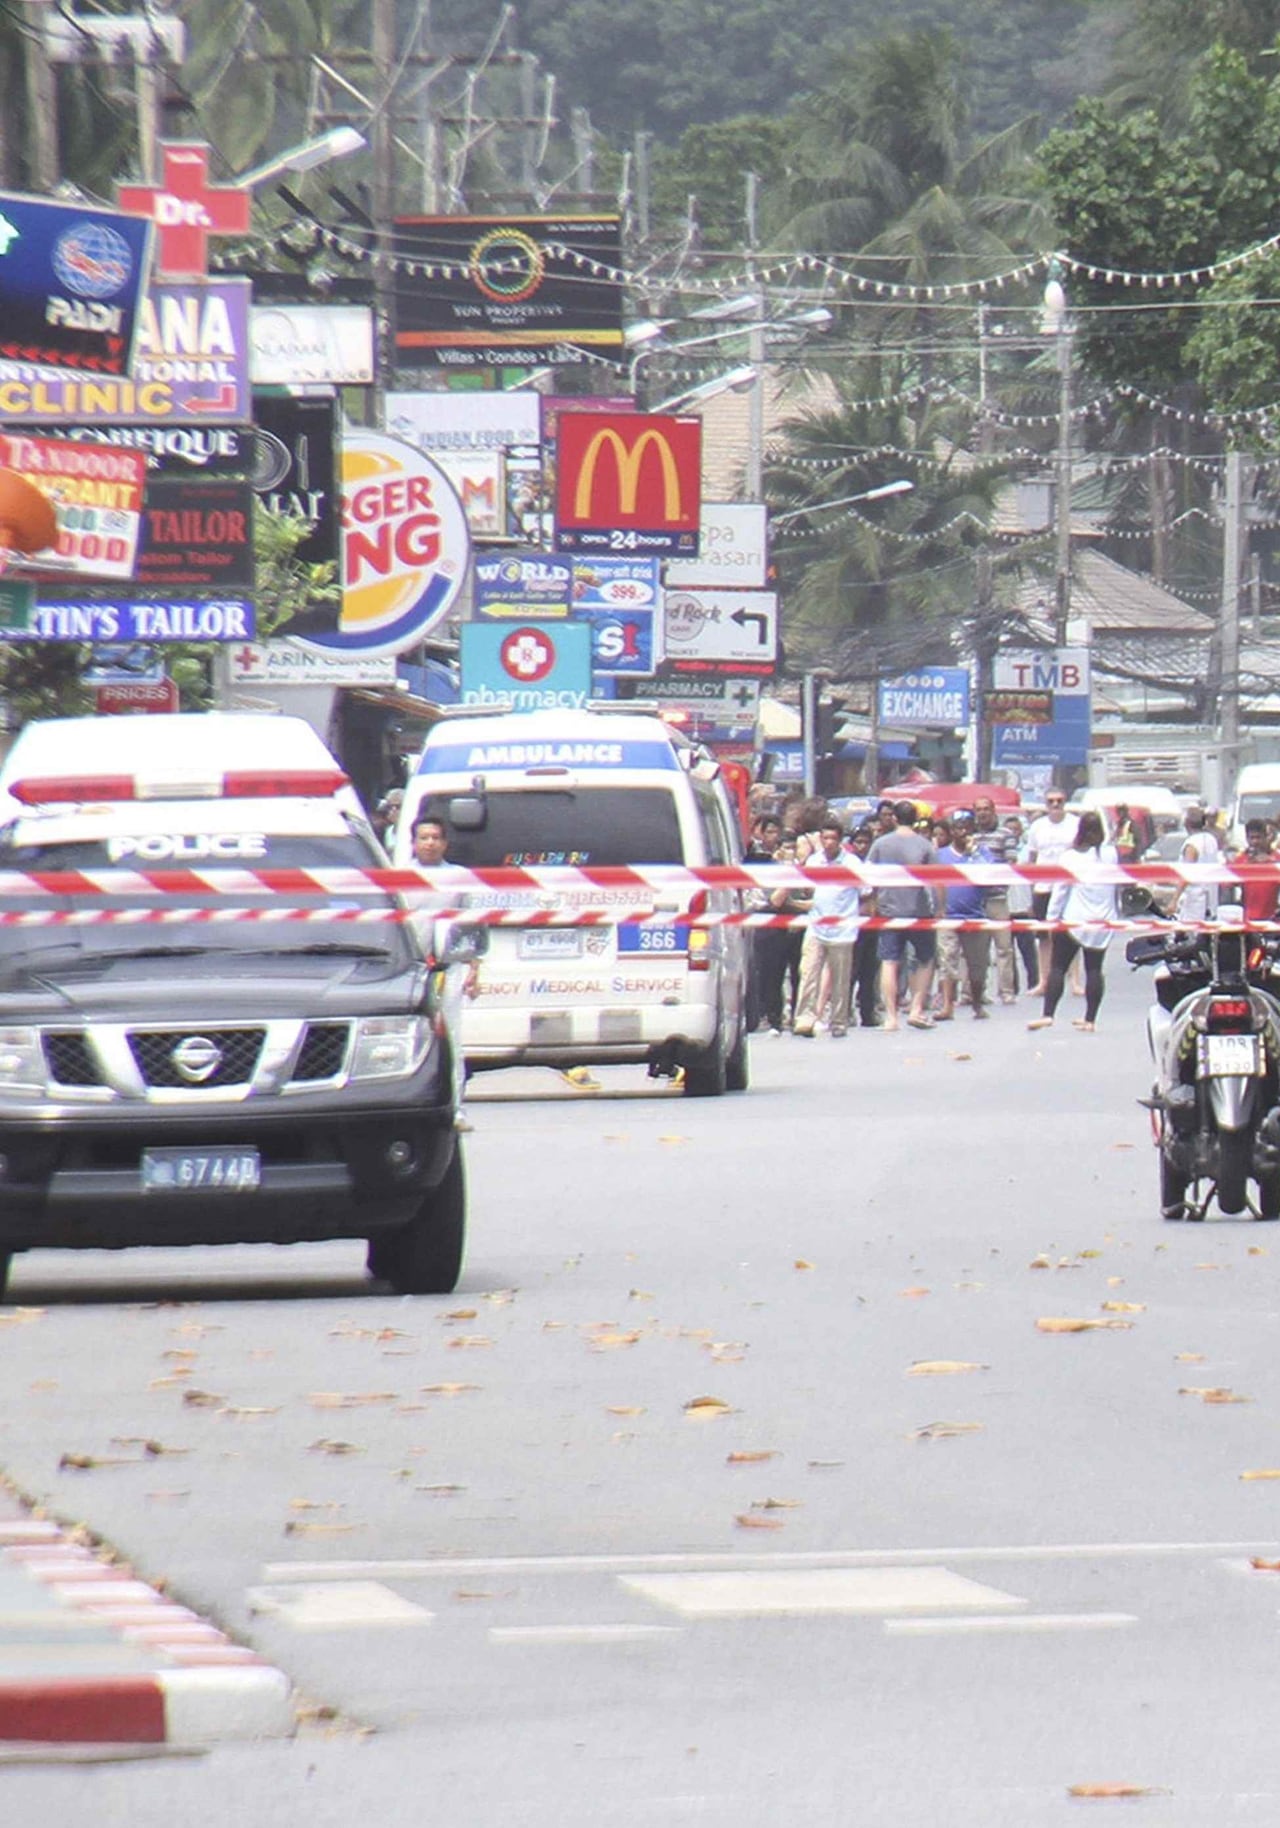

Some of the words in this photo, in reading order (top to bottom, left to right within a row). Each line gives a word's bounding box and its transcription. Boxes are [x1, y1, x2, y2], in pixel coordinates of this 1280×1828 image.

[154, 192, 212, 226] Dr.
[0, 381, 173, 414] CLINIC
[151, 510, 246, 544] TAILOR
[610, 530, 637, 549] 24
[130, 603, 248, 637] TAILOR
[1012, 660, 1081, 688] TMB
[637, 682, 722, 696] PHARMACY
[882, 691, 963, 719] EXCHANGE
[1001, 727, 1038, 742] ATM
[468, 743, 623, 766] AMBULANCE
[108, 833, 267, 863] POLICE
[639, 931, 676, 950] 366
[530, 979, 604, 994] MEDICAL
[612, 976, 683, 992] SERVICE
